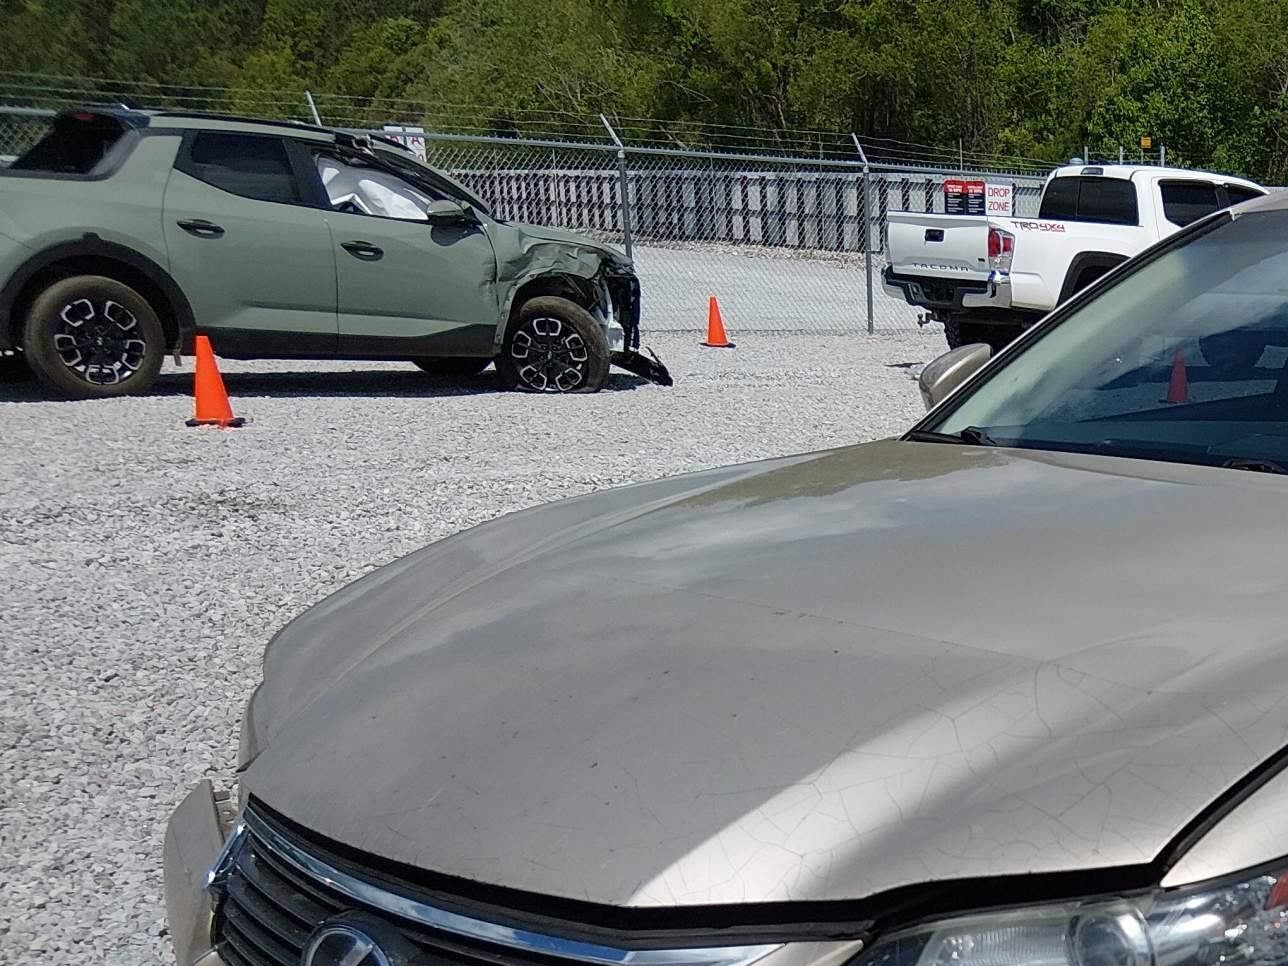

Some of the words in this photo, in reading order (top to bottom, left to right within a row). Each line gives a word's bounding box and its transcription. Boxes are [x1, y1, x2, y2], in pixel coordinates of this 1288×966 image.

[988, 188, 1009, 197] DROP
[988, 201, 1009, 211] ZONE
[912, 262, 969, 272] TACOMA
